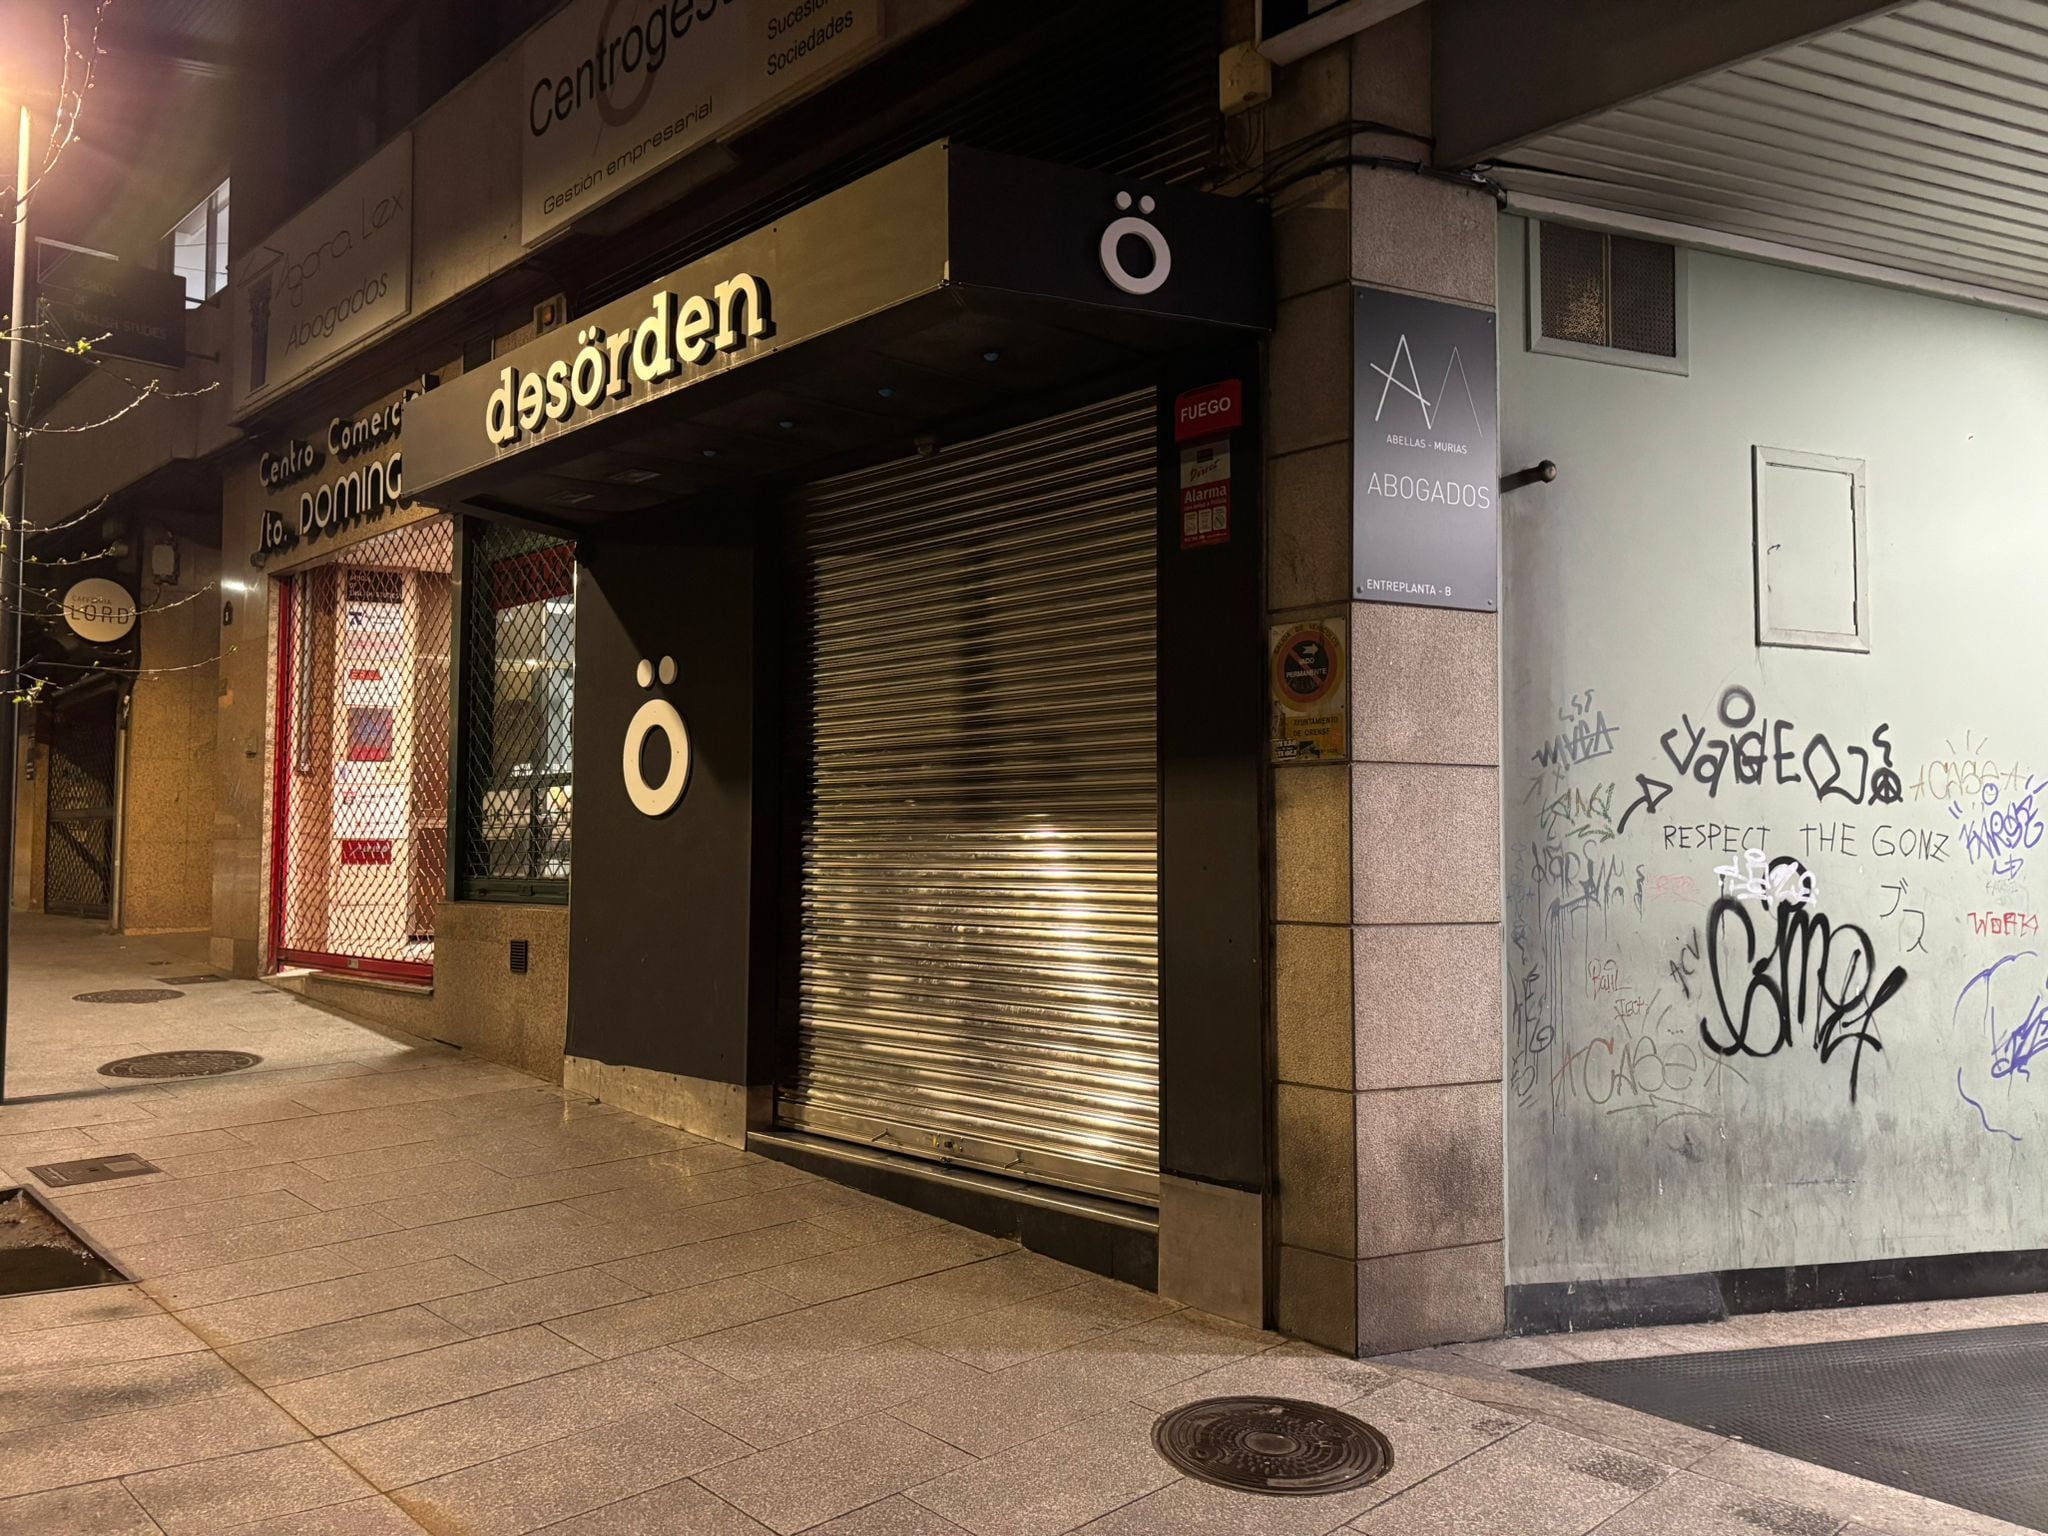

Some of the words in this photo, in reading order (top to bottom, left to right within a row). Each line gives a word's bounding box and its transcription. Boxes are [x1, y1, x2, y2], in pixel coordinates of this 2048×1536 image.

[767, 0, 833, 40] Sucesio
[767, 10, 854, 76] Sociedades
[530, 0, 733, 137] Centroge
[543, 168, 603, 215] Gestión
[606, 96, 713, 176] empresarial
[362, 194, 404, 240] Lex
[285, 272, 388, 357] Abogados
[485, 272, 765, 445] desörden
[1181, 397, 1231, 423] FUEGO
[259, 439, 314, 487] Centro
[1386, 433, 1427, 449] ABELLAS
[1434, 441, 1468, 455] MURIAS
[300, 452, 402, 536] DOMING
[1184, 486, 1227, 504] Alarma
[1367, 471, 1491, 510] ABOGADOS
[1366, 578, 1437, 596] ENTREPLANTA
[1444, 585, 1452, 597] B
[71, 604, 129, 624] LORD
[1286, 667, 1328, 679] PERMANENTE
[1293, 716, 1339, 726] AYUNTAMIENTO
[1293, 729, 1302, 737] DE
[1663, 822, 1771, 853] RESPECT
[1800, 821, 1858, 857] THE
[1872, 825, 1951, 863] GONZ
